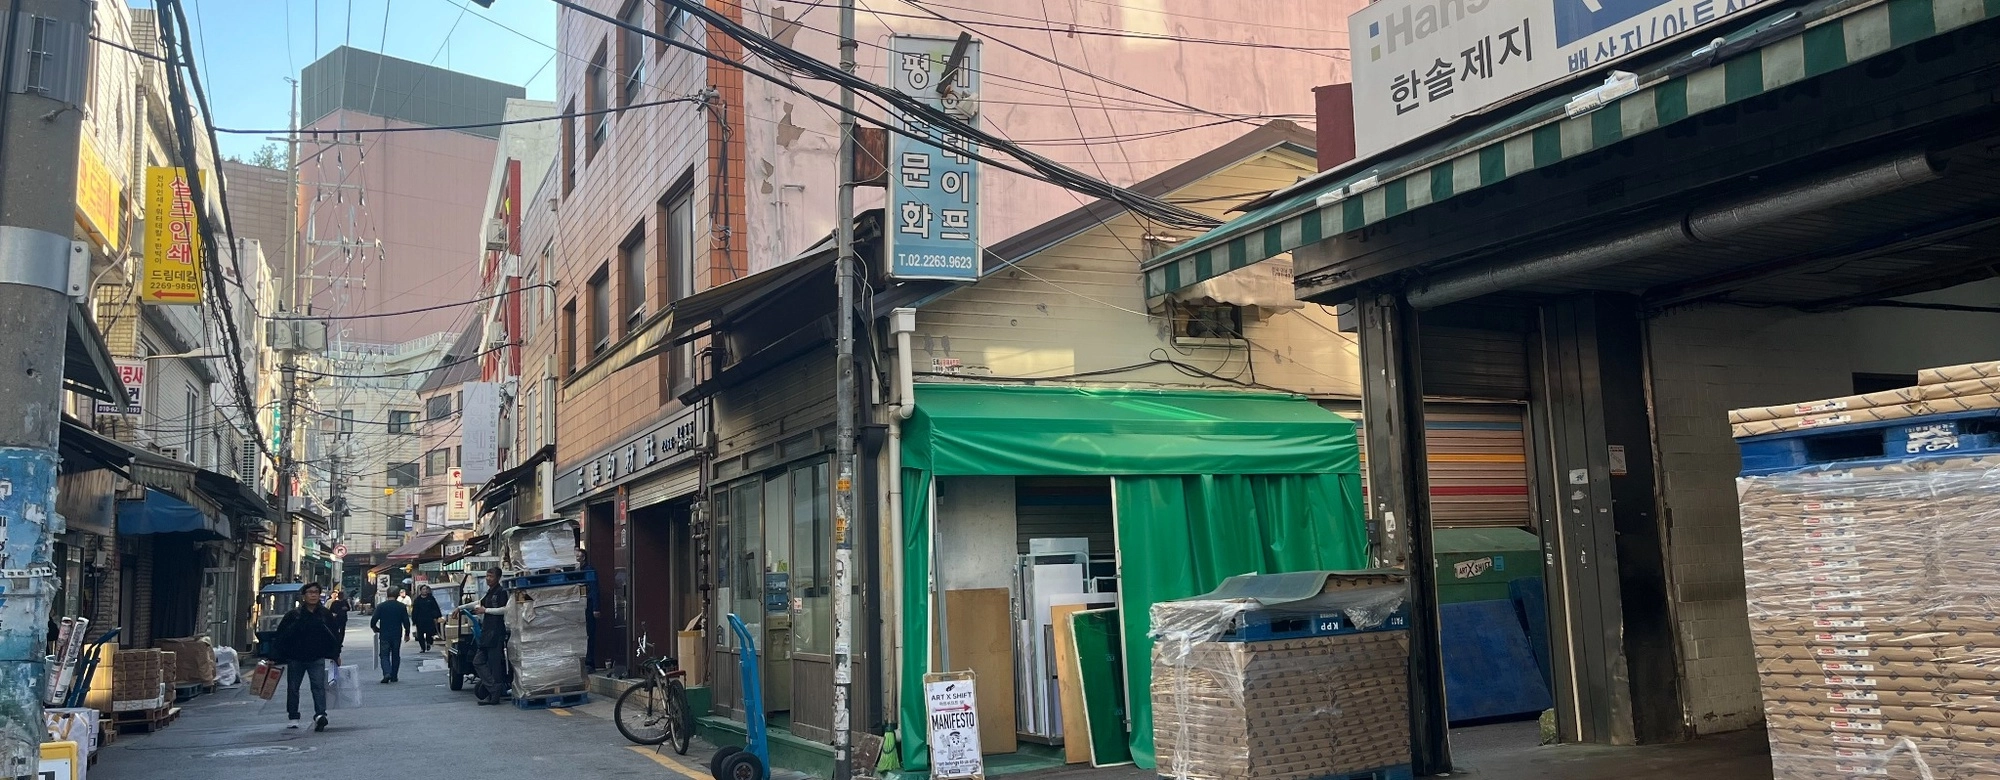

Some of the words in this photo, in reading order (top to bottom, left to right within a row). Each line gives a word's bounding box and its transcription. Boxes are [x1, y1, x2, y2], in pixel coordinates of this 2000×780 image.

[1390, 17, 1533, 116] 한솔제지
[167, 176, 195, 265] 실크인쇄
[898, 253, 972, 270] T.02.2263.9623
[151, 269, 197, 282] 드림데칼
[150, 282, 197, 290] 2269-9890
[116, 365, 143, 384] 공사
[1320, 621, 1339, 631] KPP
[953, 691, 972, 700] SHIFT
[931, 712, 975, 731] MANIFESTO
